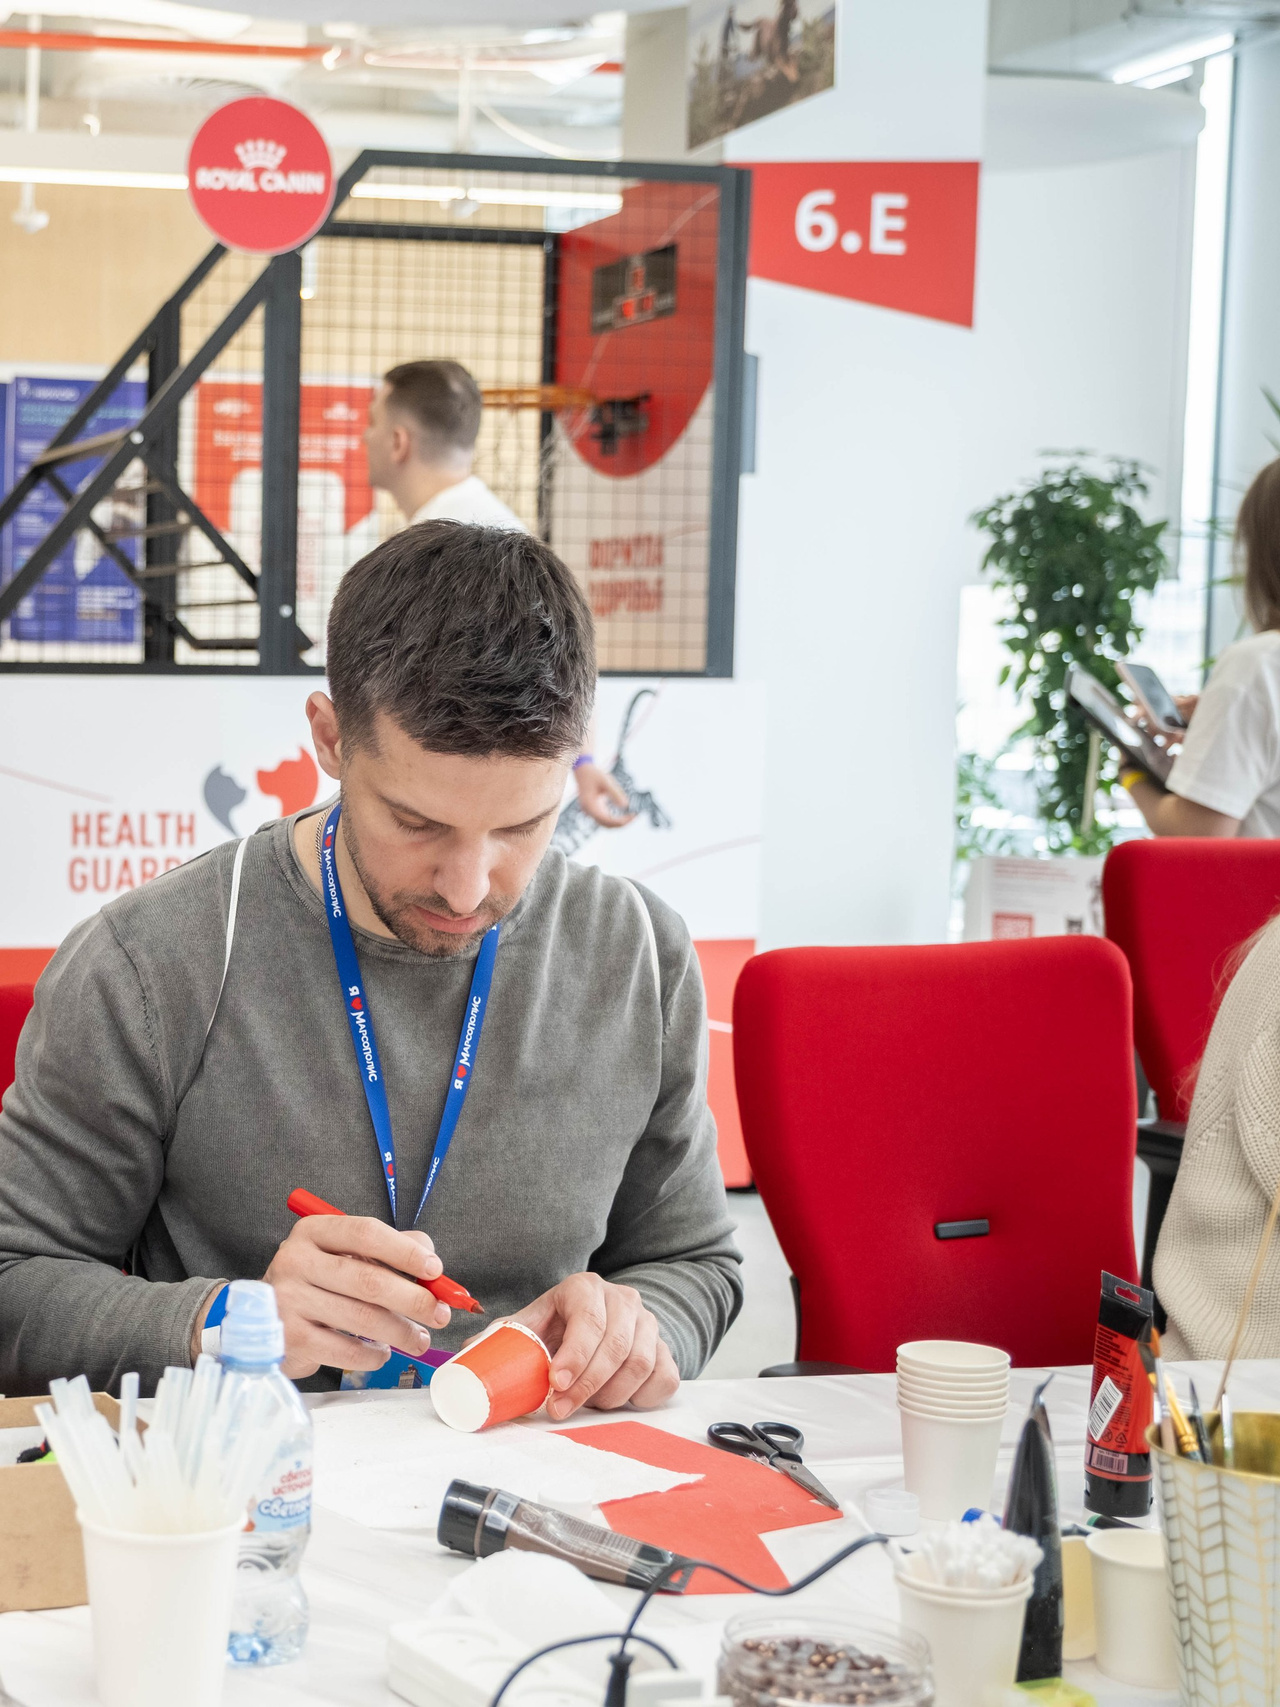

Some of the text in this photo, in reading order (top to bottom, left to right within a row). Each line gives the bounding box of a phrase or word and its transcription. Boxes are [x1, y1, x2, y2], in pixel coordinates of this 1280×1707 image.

[795, 188, 908, 256] 6.E
[71, 812, 196, 848] HEALTH
[326, 824, 335, 835] Я
[348, 985, 359, 997] Я
[454, 1078, 463, 1090] Я
[384, 1151, 393, 1163] Я
